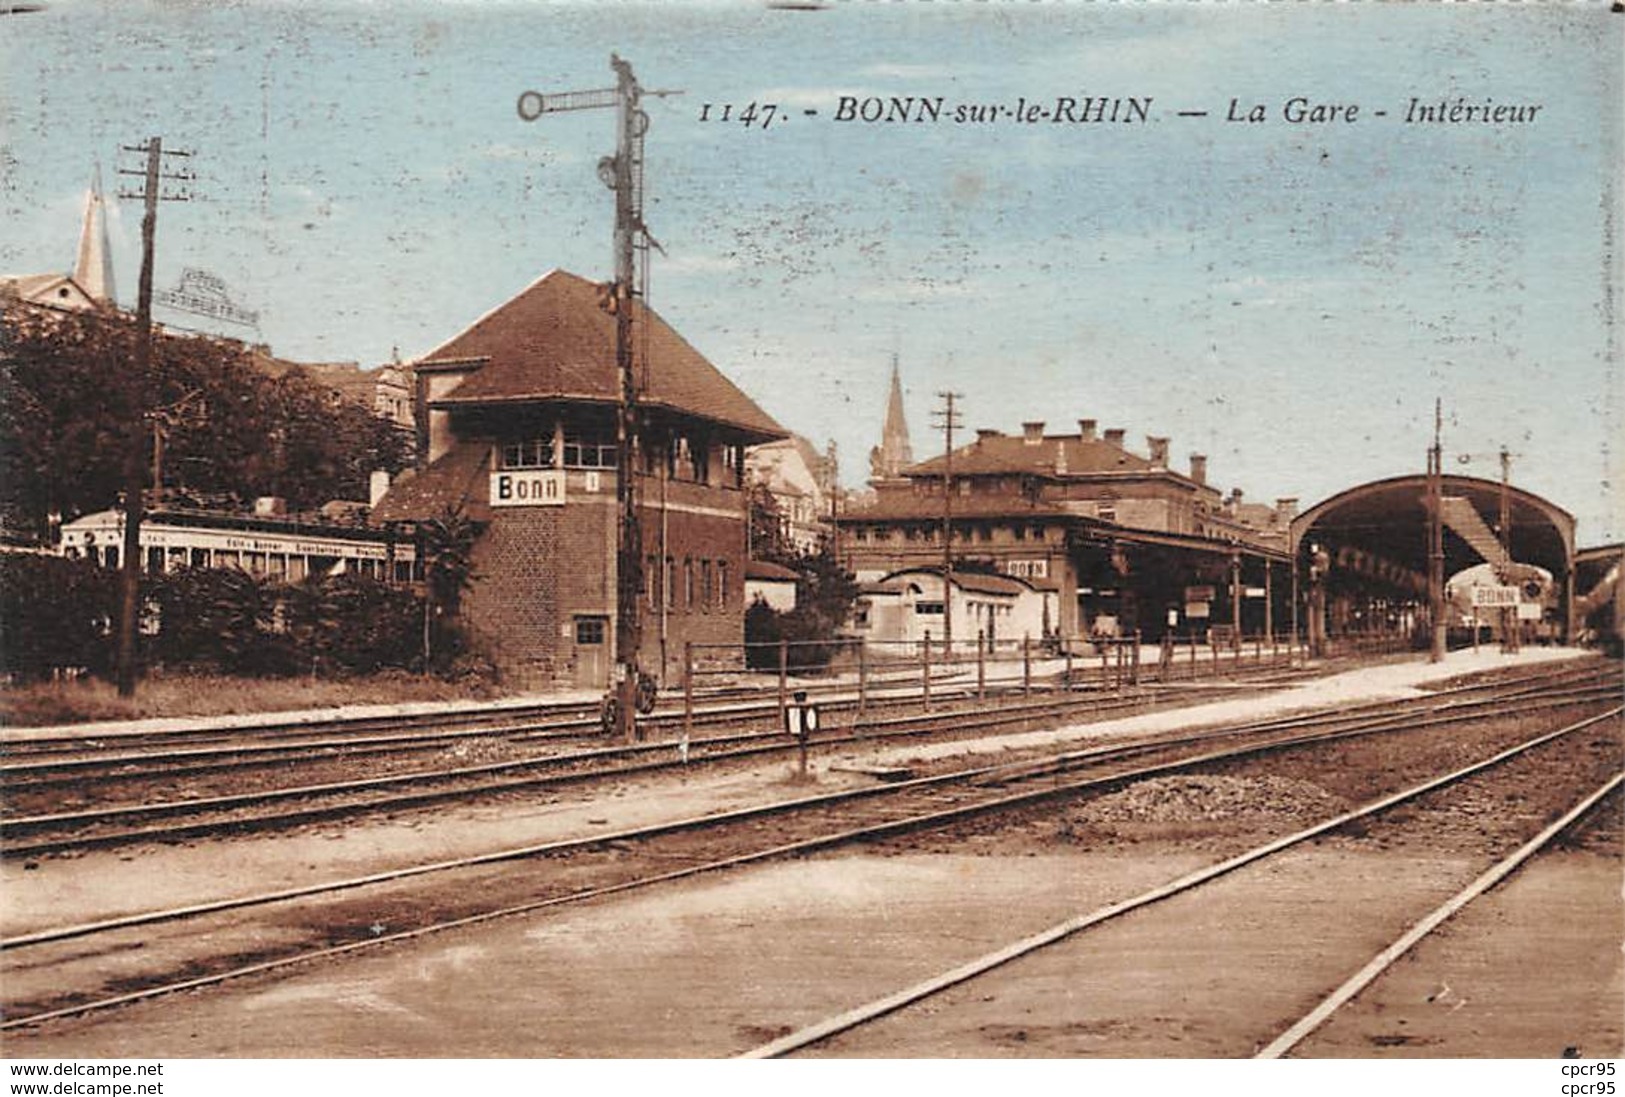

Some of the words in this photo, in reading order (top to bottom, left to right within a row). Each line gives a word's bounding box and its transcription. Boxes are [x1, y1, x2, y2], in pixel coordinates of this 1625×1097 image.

[699, 102, 789, 129] 1147.
[1227, 98, 1266, 123] La
[1284, 97, 1359, 123] Gare
[1405, 98, 1543, 123] Intérieur
[499, 475, 557, 499] Bonn
[1477, 589, 1515, 603] BONN
